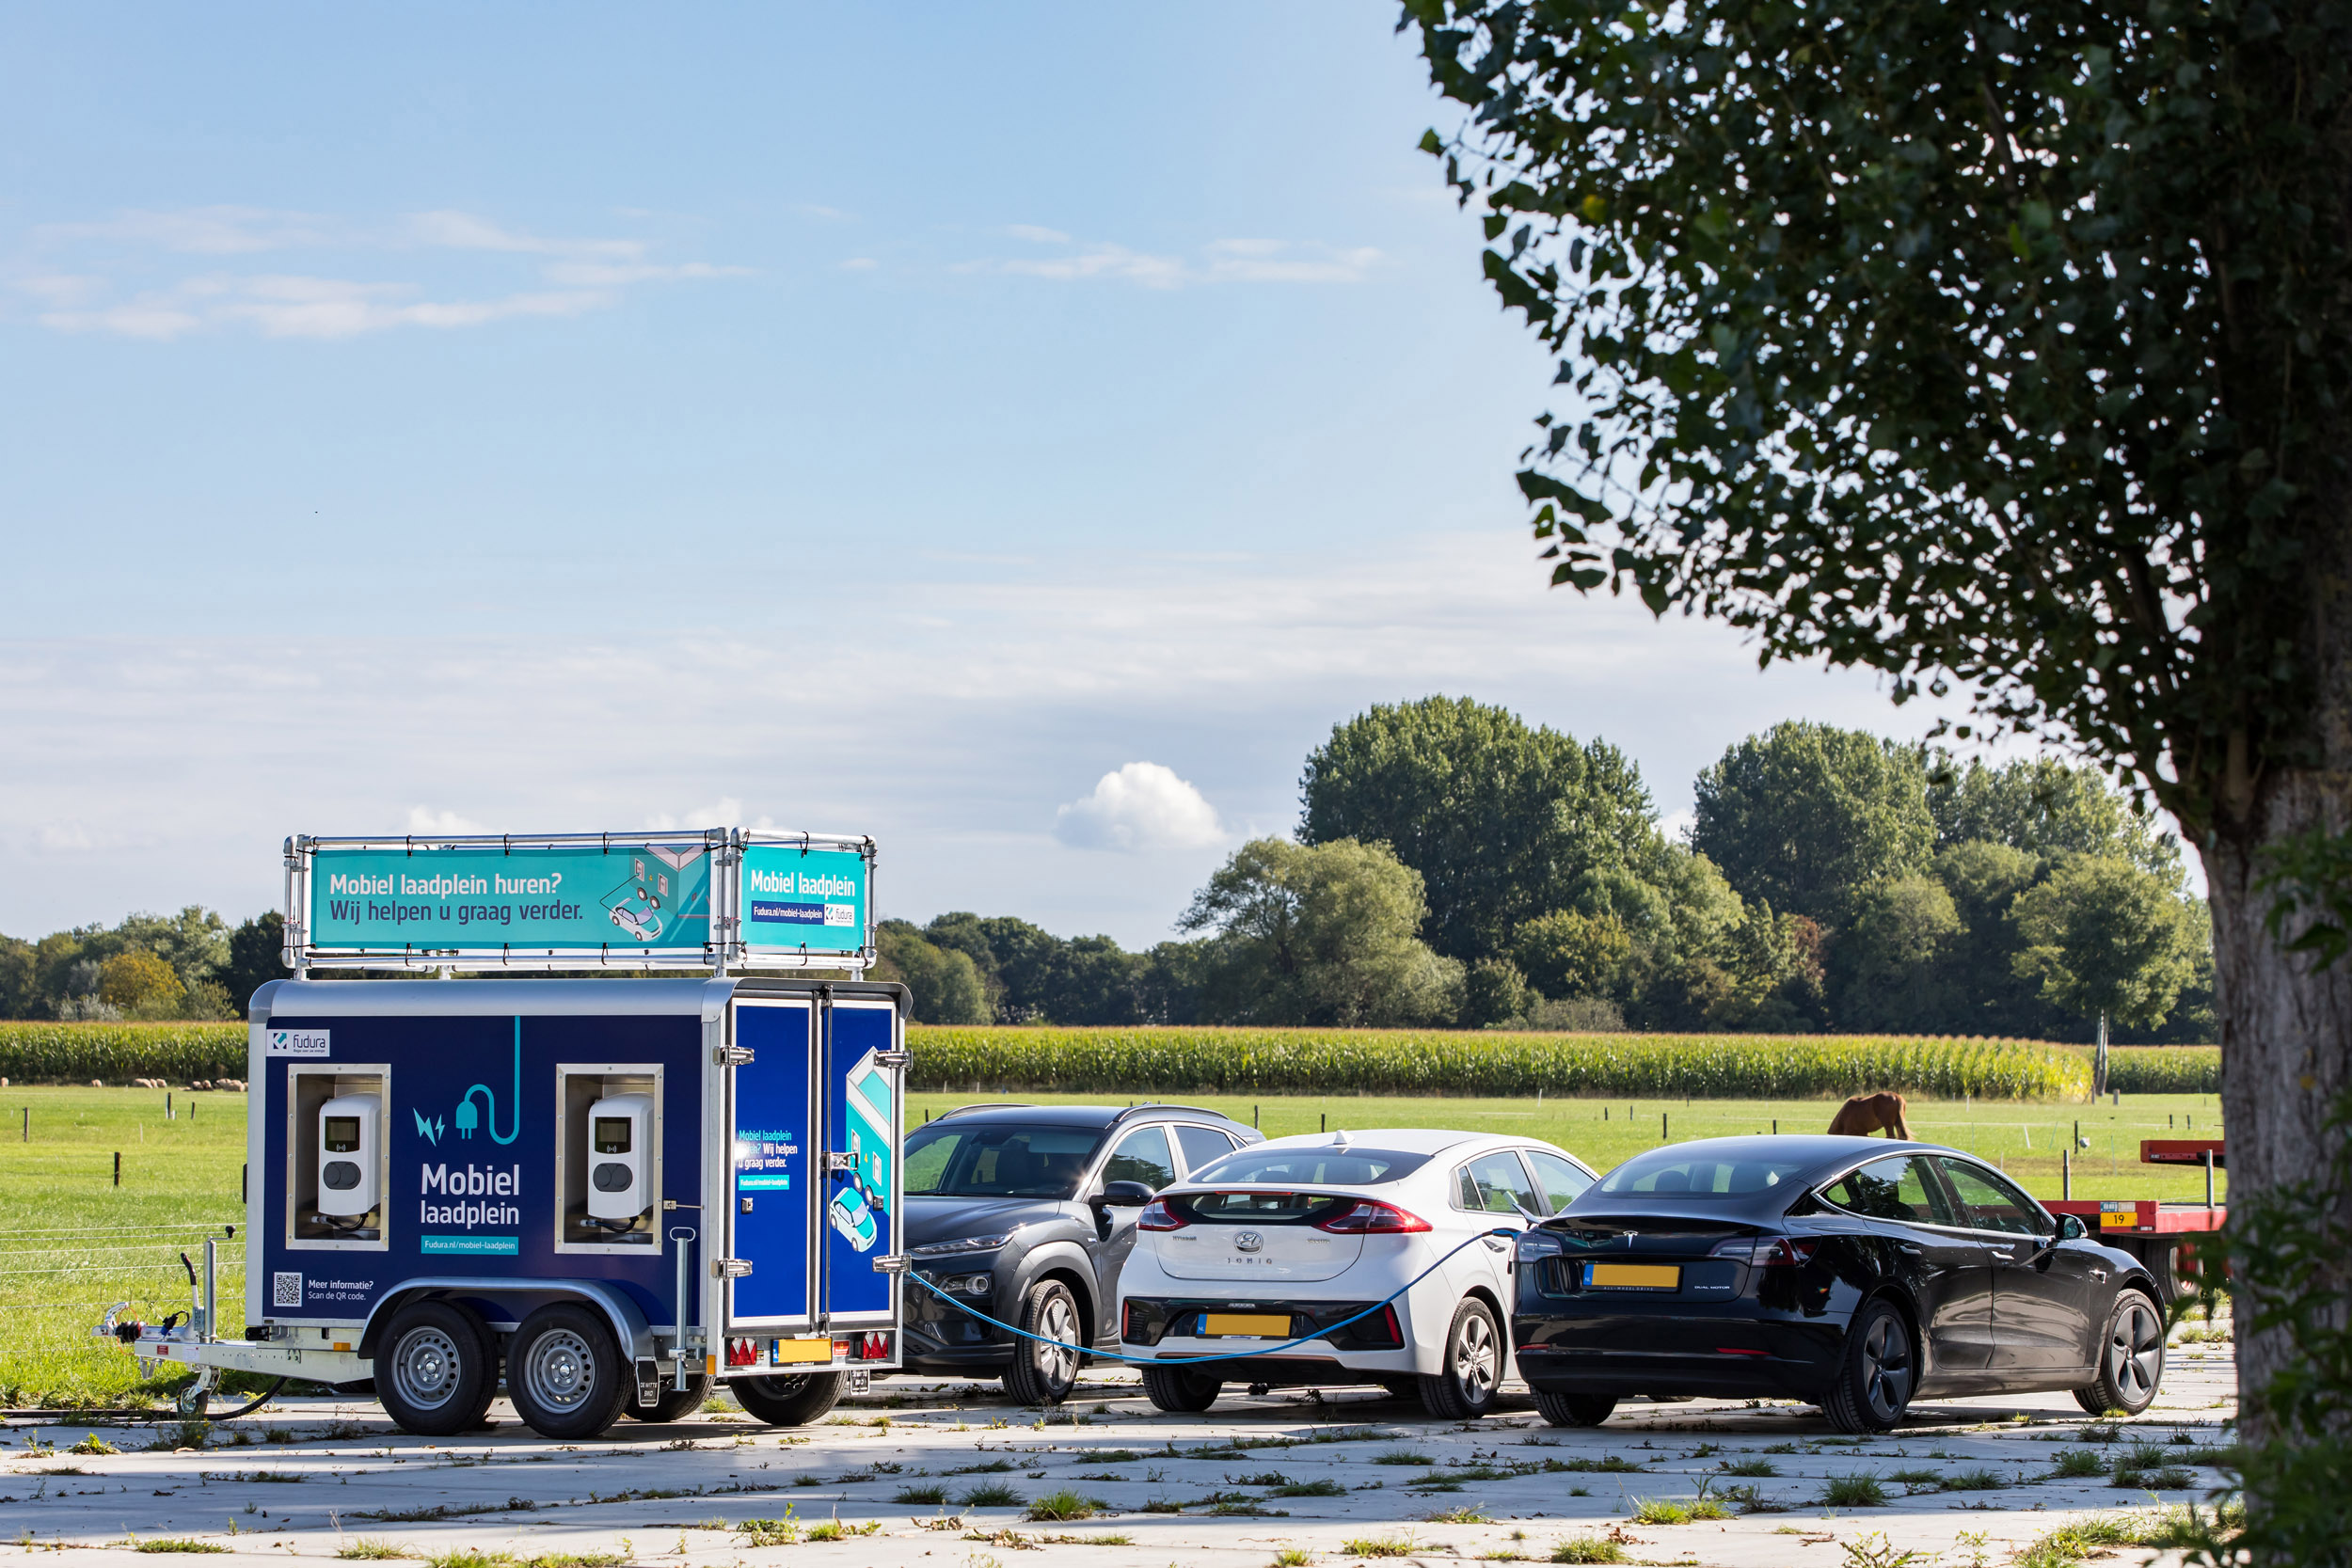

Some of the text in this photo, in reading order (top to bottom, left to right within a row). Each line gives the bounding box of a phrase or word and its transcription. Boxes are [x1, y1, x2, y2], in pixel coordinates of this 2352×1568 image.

[329, 872, 563, 900] Mobiel laadplein huren?
[751, 869, 855, 901] Mobiel laadplein
[329, 898, 584, 926] Wij helpen u graag verder.
[754, 906, 823, 921] Fudura.nl/mobiel-laadplein
[293, 1034, 326, 1049] fudura
[739, 1130, 792, 1144] Mobiel laadplein
[763, 1143, 774, 1157] Wij
[775, 1143, 798, 1157] helpen
[744, 1158, 764, 1170] graag
[765, 1156, 787, 1168] verder.
[421, 1163, 519, 1196] Mobiel
[421, 1199, 519, 1229] laadplein
[2113, 1214, 2124, 1225] 19
[424, 1240, 516, 1251] Fudura.nl/mobiel-laadplein
[308, 1279, 374, 1290] Meer informatie?
[336, 1291, 347, 1301] QR
[347, 1292, 367, 1301] code.
